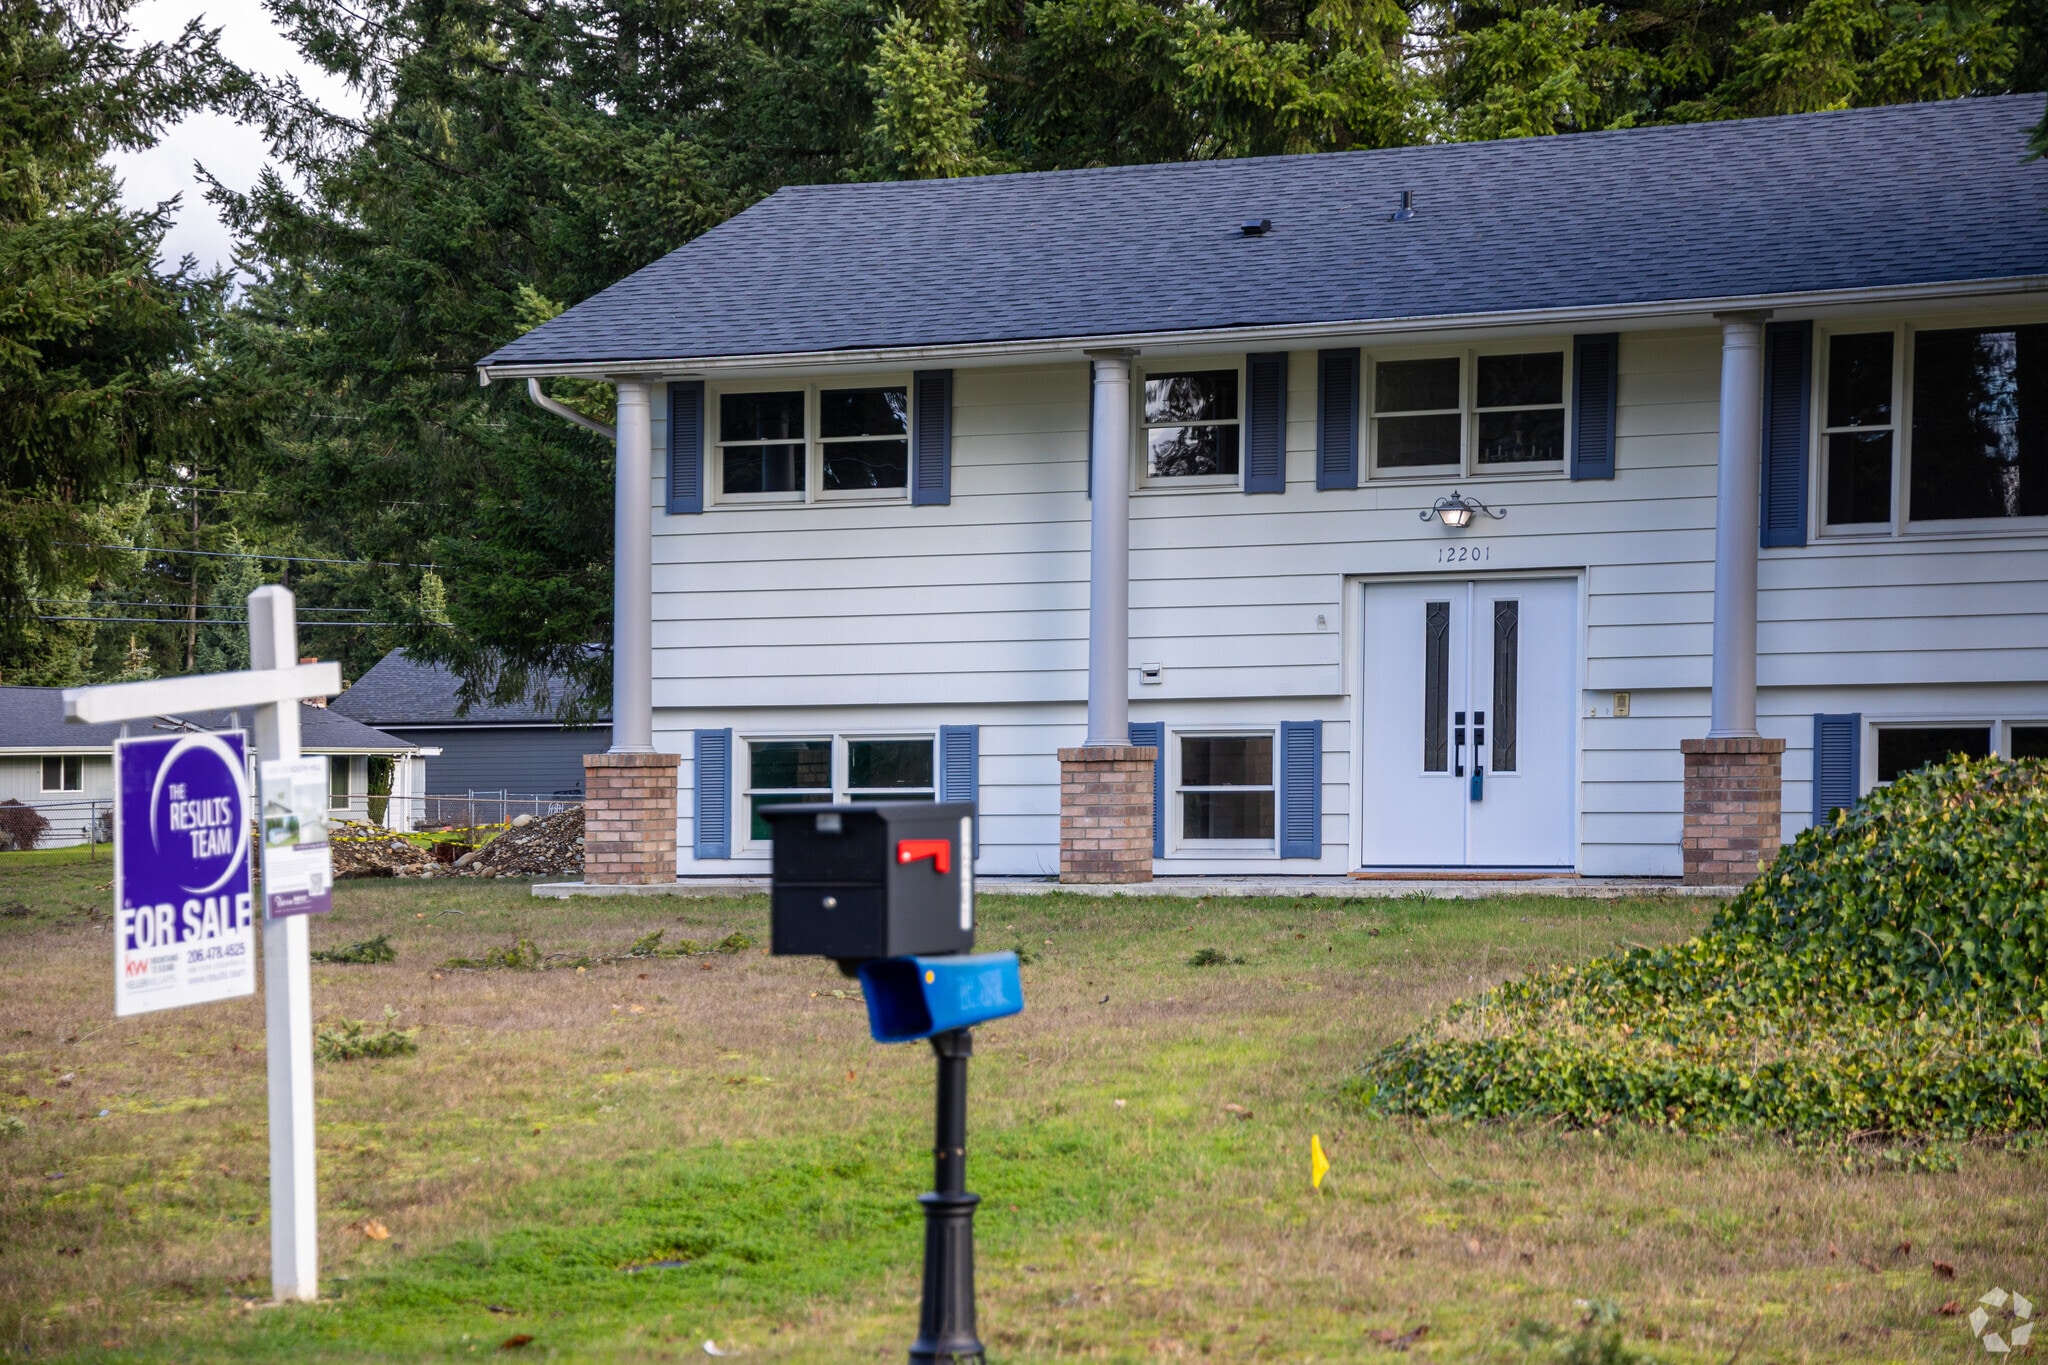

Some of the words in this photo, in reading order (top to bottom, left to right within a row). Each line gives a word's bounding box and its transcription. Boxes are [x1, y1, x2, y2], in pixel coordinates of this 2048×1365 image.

[1438, 546, 1490, 563] 12201
[169, 783, 186, 800] THE
[170, 797, 232, 831] RESULTS
[190, 828, 232, 858] TEAM
[121, 903, 176, 951] FOR
[182, 893, 252, 941] SALE
